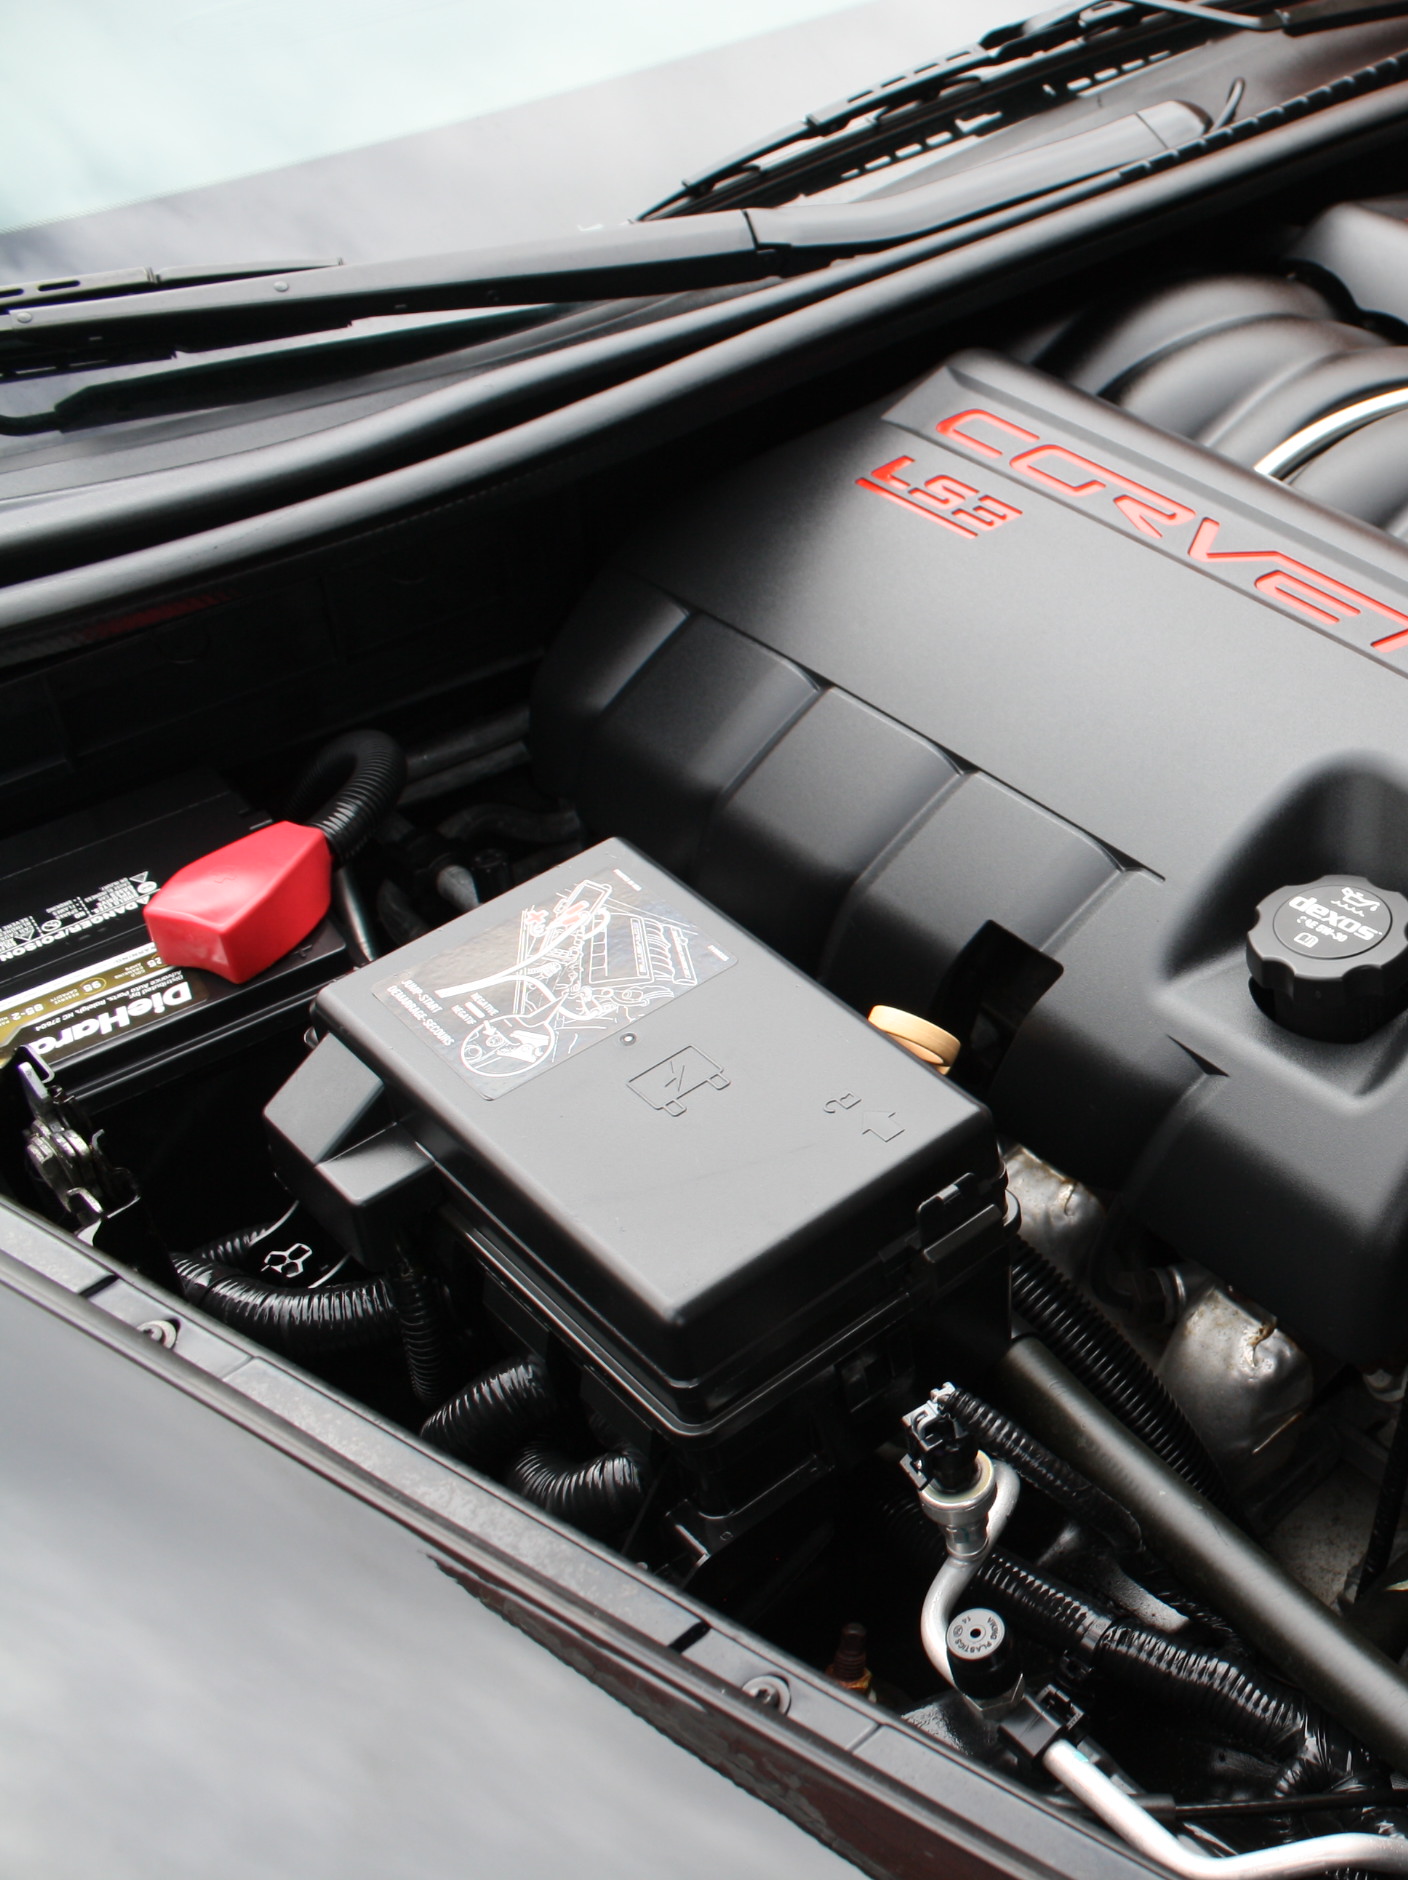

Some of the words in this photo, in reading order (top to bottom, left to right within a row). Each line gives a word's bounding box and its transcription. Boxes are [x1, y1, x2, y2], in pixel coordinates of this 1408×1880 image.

[860, 455, 1023, 537] LS3
[1289, 897, 1377, 941] dexos
[0, 902, 139, 962] DANGER/POISON
[1315, 925, 1348, 942] 5W-30
[130, 983, 149, 992] Auto
[142, 974, 184, 994] Distributed
[150, 970, 182, 985] Advance
[401, 979, 443, 1013] JUMP-START
[470, 992, 499, 1016] NEGATIVE
[62, 1012, 75, 1021] NC
[387, 985, 455, 1046] DEMARRAGE-SECOURS
[451, 1004, 477, 1025] NEGATIF
[987, 1616, 999, 1640] VIKING
[954, 1638, 993, 1654] PLASTICS
